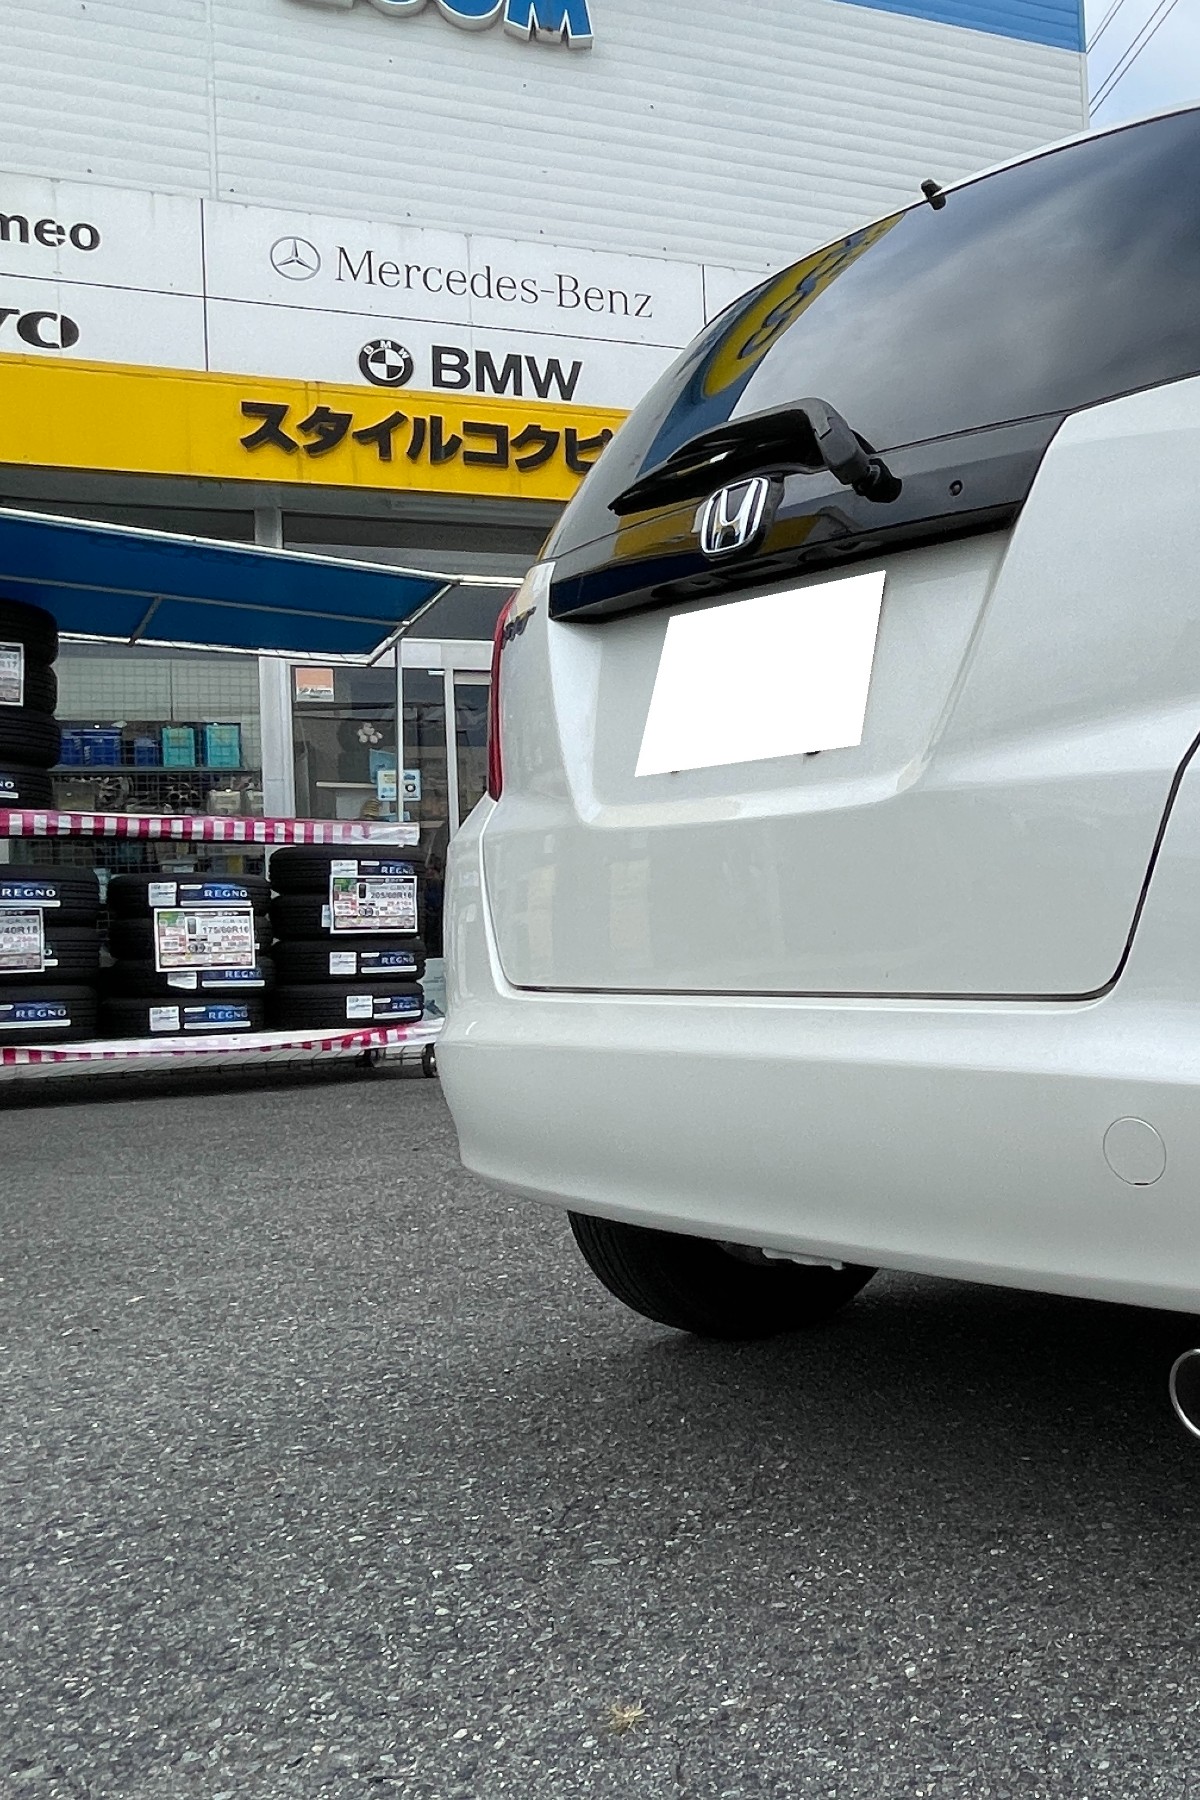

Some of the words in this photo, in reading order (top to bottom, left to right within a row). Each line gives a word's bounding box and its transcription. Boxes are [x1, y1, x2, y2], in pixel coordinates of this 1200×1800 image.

[335, 246, 653, 318] Mercedes-Benz
[431, 345, 583, 402] BMW
[1, 888, 57, 898] REGNO
[203, 889, 248, 898] REGNO
[15, 1008, 68, 1018] REGNO
[208, 1010, 249, 1019] REGNO
